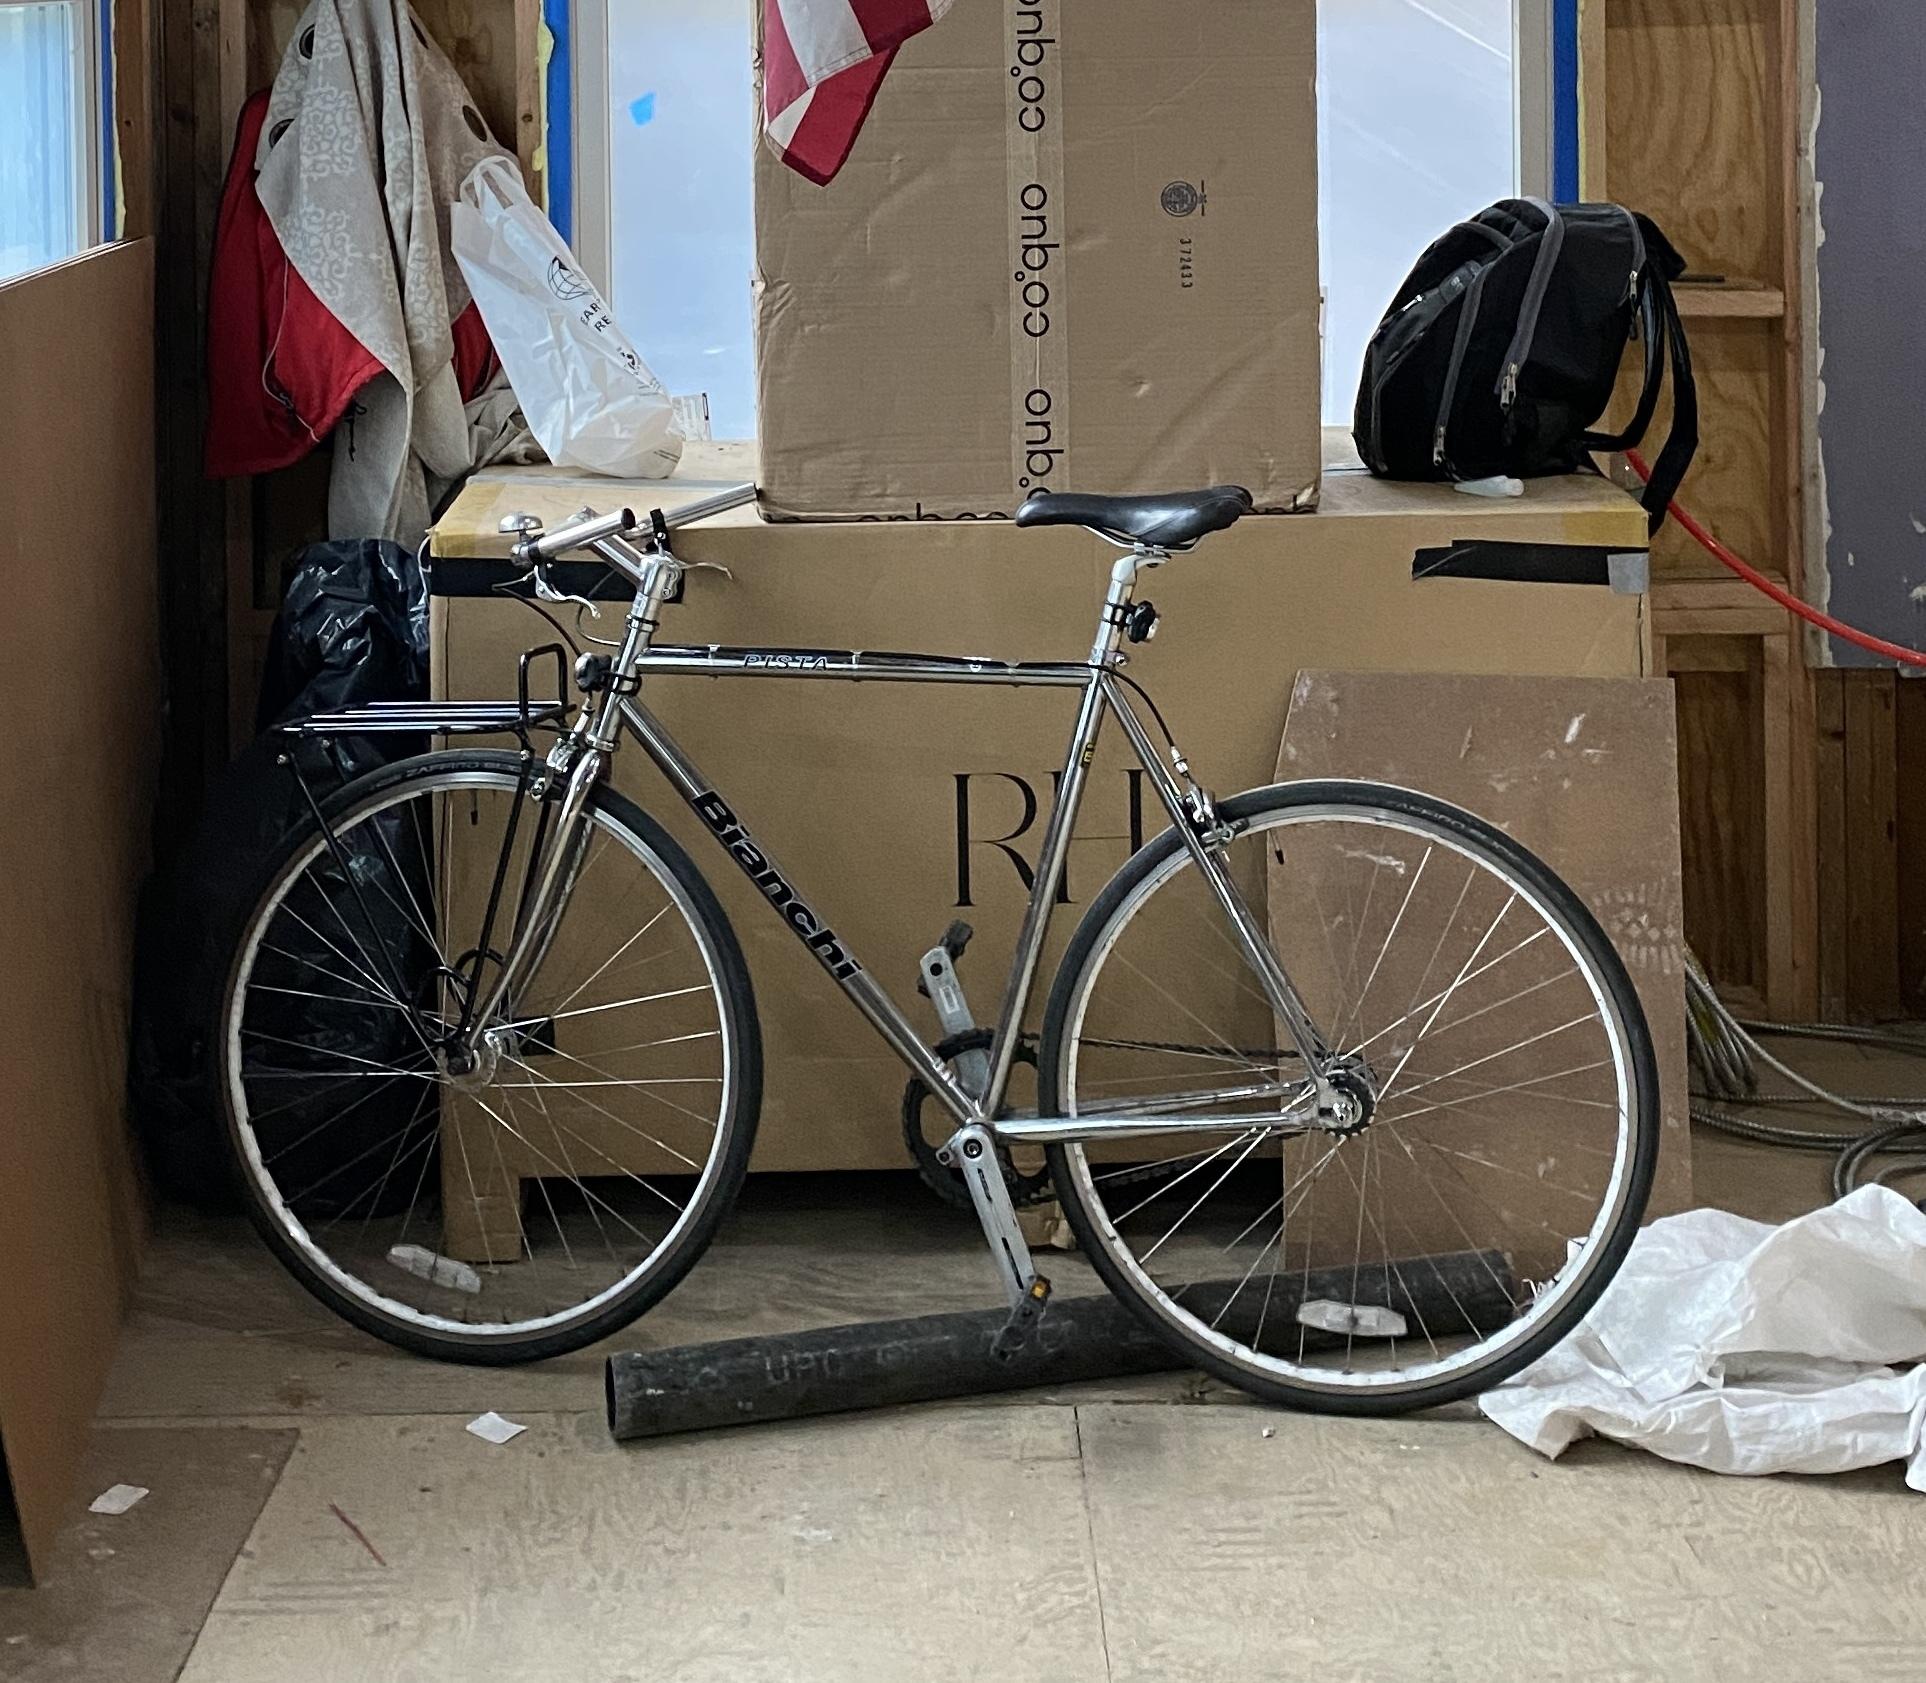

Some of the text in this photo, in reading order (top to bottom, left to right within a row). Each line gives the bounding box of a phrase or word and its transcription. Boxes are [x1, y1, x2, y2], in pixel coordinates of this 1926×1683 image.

[1179, 238, 1193, 288] 372433
[580, 298, 602, 326] EAR
[743, 654, 829, 672] PISTA
[952, 768, 1146, 907] RH
[691, 790, 863, 981] Bianchi
